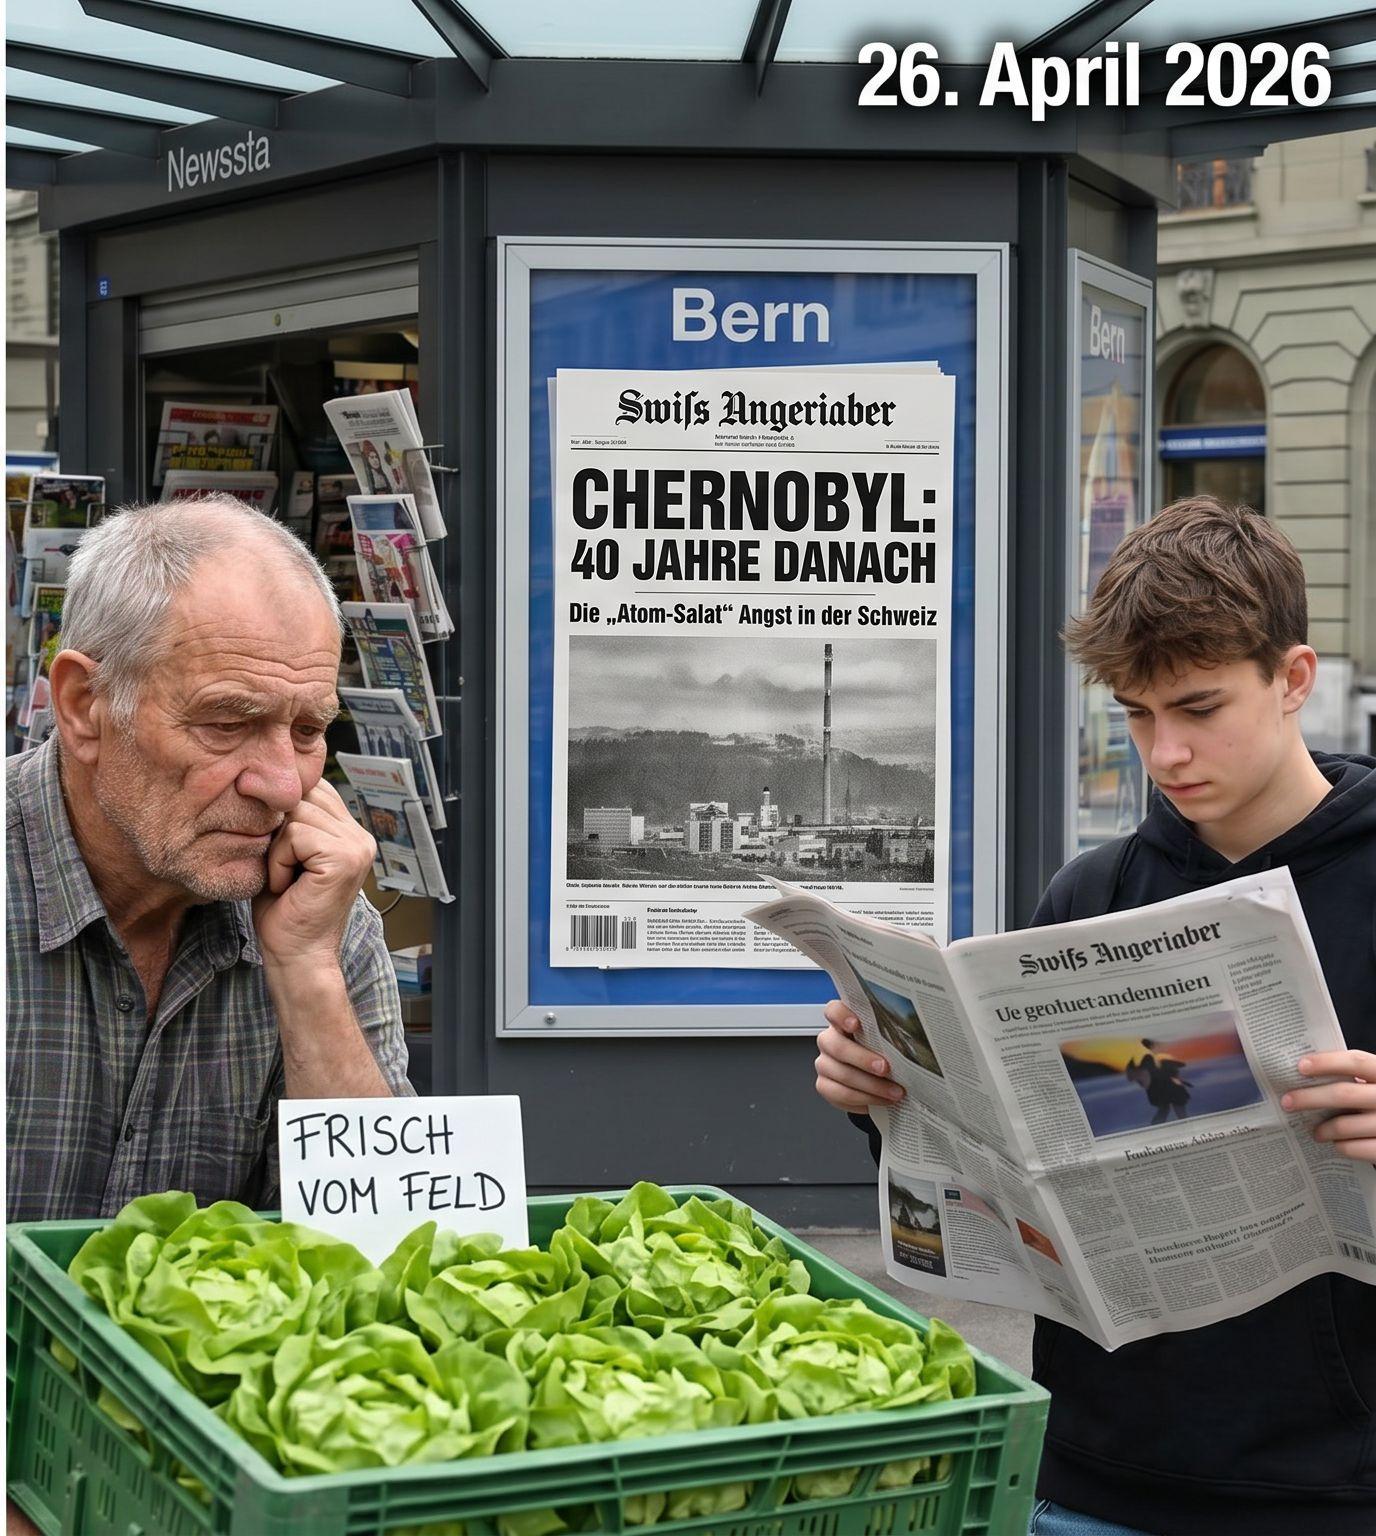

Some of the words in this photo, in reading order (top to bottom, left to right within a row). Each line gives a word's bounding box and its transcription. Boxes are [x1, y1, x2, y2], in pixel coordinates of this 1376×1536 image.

[167, 130, 270, 192] Newssta
[673, 287, 829, 343] Bern
[1089, 305, 1125, 365] Bern
[573, 468, 935, 533] CHERNOBYL:
[571, 539, 619, 580] 40
[633, 539, 760, 581] JAHRE
[775, 541, 935, 584] DANACH
[570, 603, 599, 623] Die
[739, 605, 792, 628] Angst
[799, 605, 815, 624] in
[822, 606, 851, 625] der
[858, 606, 937, 626] Schweiz
[287, 1113, 453, 1160] FRISCH
[298, 1177, 378, 1216] VOM
[399, 1171, 505, 1211] FELD
